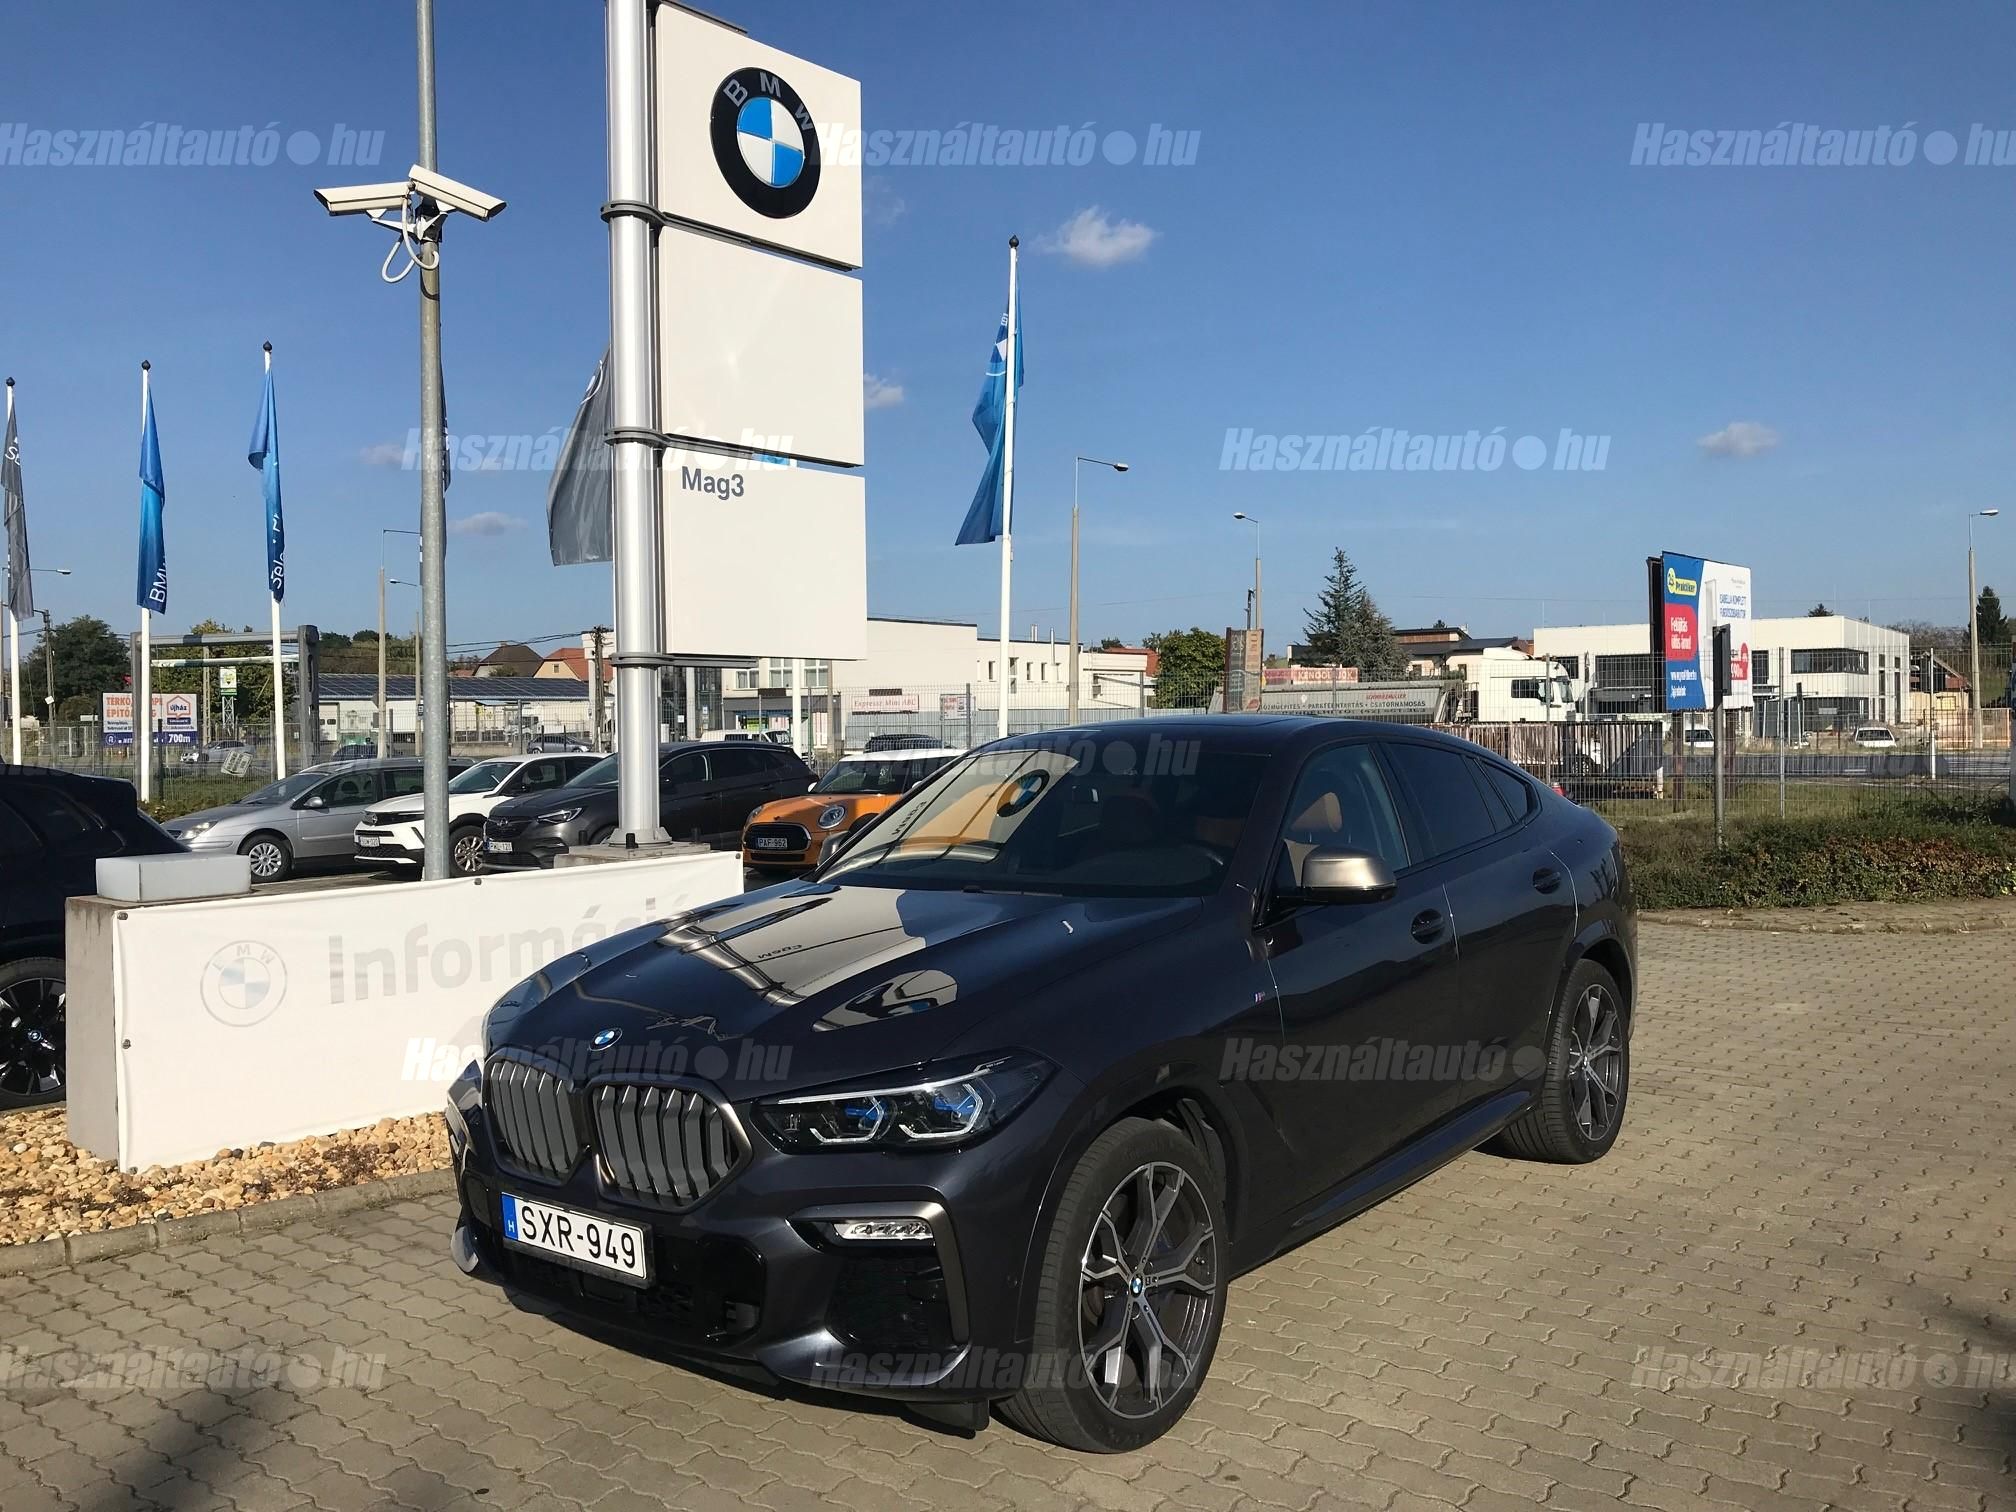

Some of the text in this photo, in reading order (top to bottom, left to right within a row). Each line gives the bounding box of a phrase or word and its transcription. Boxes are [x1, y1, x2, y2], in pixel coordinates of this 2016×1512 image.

[723, 71, 814, 131] BMW
[681, 465, 745, 501] Mag3
[168, 733, 191, 743] 700m
[520, 1205, 637, 1269] SXR-949
